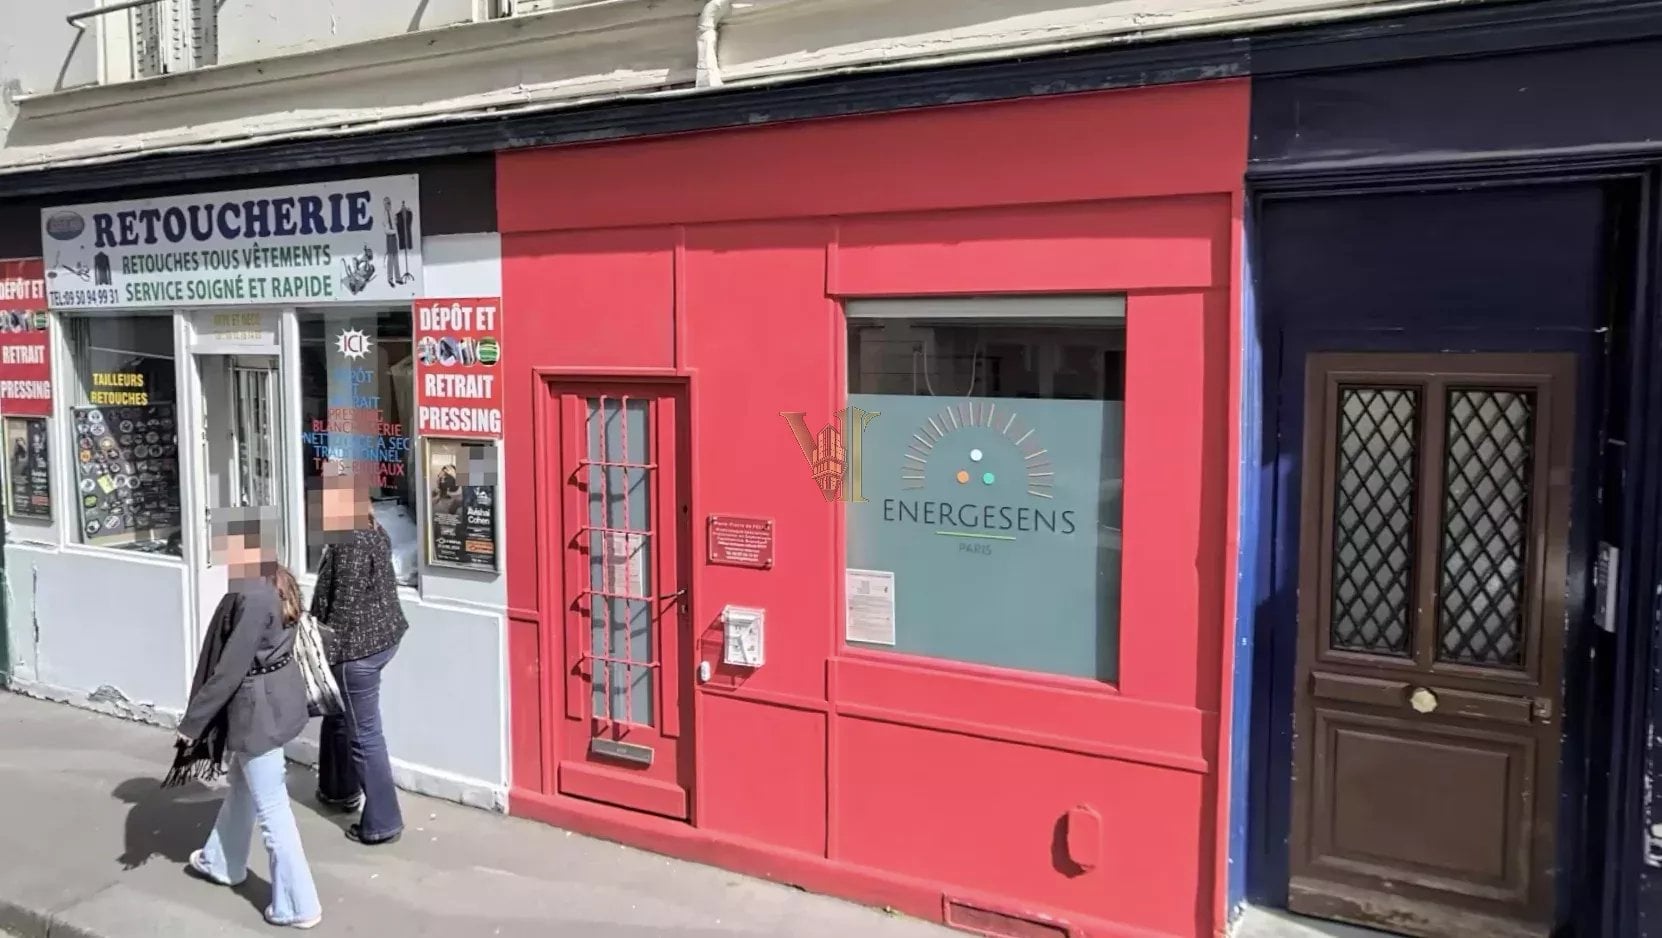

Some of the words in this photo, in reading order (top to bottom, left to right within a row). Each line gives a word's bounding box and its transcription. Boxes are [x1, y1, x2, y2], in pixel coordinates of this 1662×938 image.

[93, 190, 374, 248] RETOUCHERIE
[122, 250, 199, 275] RETOUCHES
[202, 248, 240, 270] TOUS
[242, 242, 331, 269] VÊTEMENTS
[32, 279, 45, 299] ET
[109, 288, 119, 304] 31
[125, 279, 185, 303] SERVICE
[187, 275, 243, 301] SOIGNÉ
[247, 278, 266, 298] ET
[270, 274, 333, 297] RAPIDE
[420, 302, 473, 331] DÉPÔT
[475, 306, 497, 331] ET
[343, 334, 362, 353] ICI
[2, 345, 45, 364] RETRAIT
[0, 380, 51, 399] PRESSING
[93, 373, 144, 387] TAILLEURS
[424, 374, 494, 399] RETRAIT
[91, 391, 149, 406] RETOUCHES
[419, 406, 502, 433] PRESSING
[388, 437, 411, 451] SEC
[883, 499, 1076, 535] ENERGESENS
